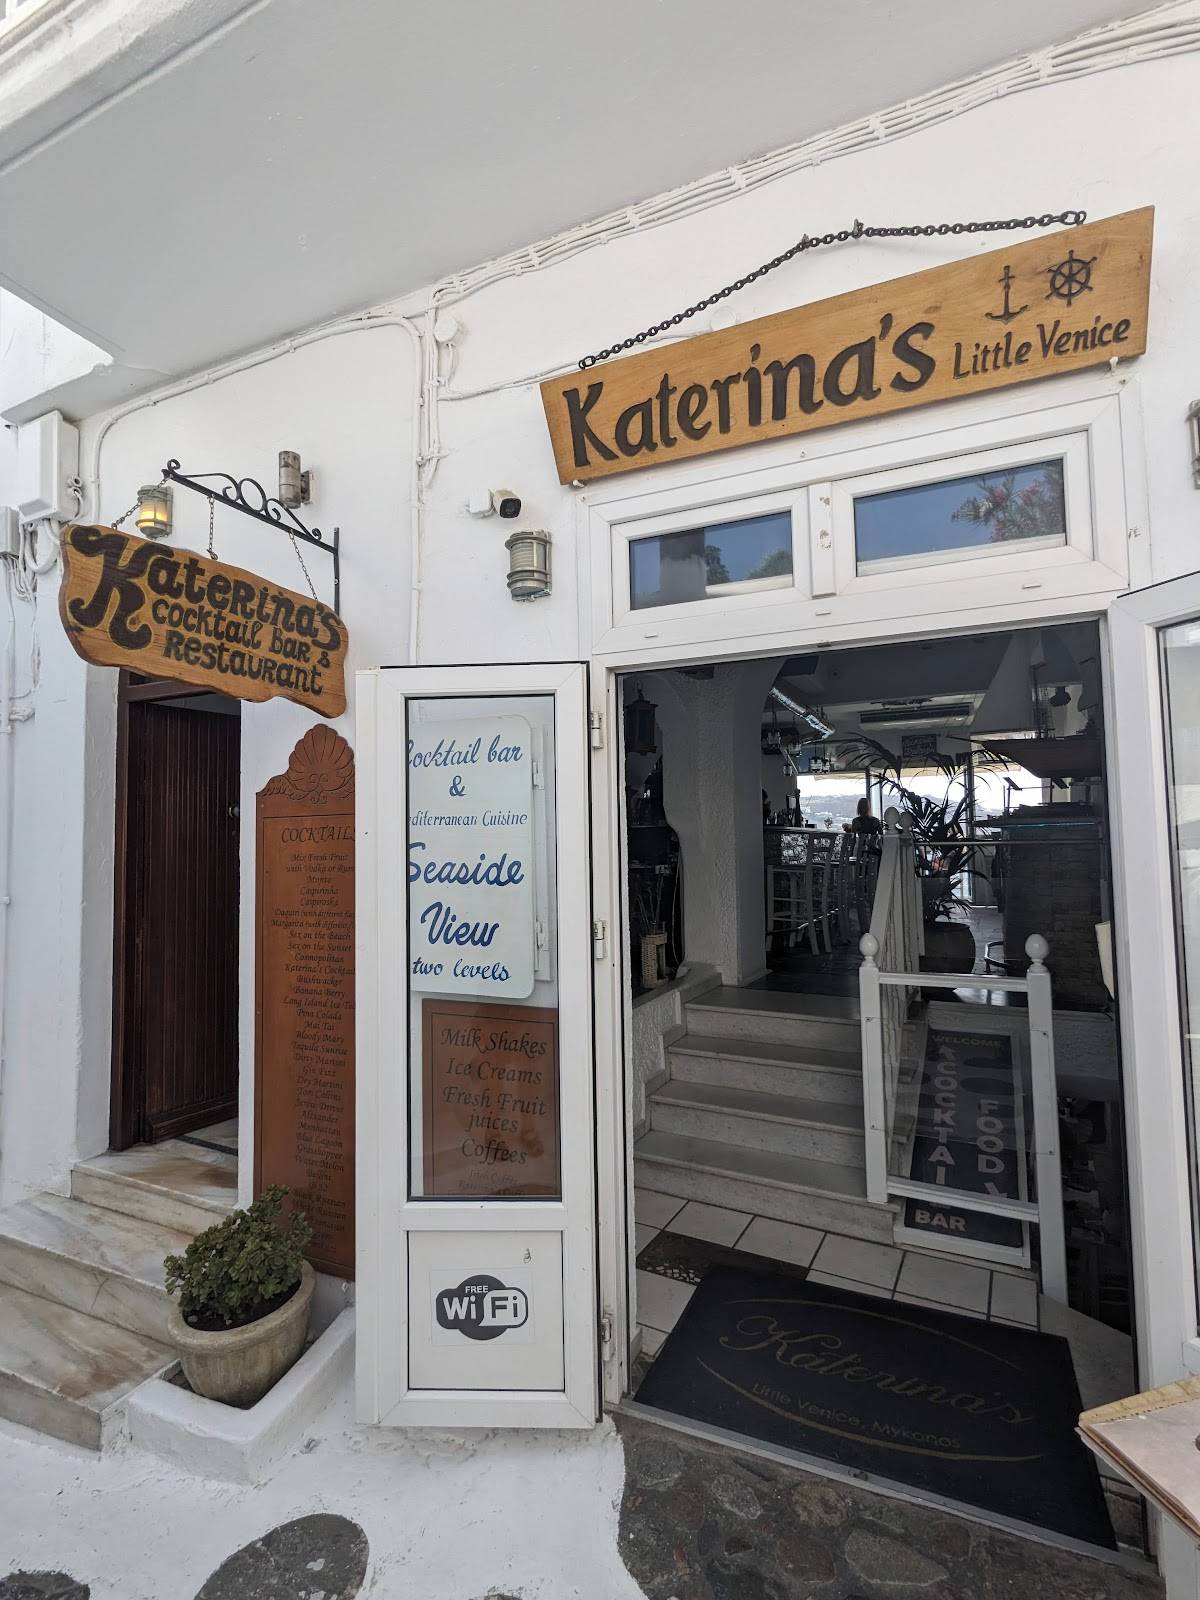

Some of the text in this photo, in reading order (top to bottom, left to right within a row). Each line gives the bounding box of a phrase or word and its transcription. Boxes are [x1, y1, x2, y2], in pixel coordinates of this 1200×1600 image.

[953, 314, 1131, 380] Little Venice
[561, 313, 936, 468] Katerina's
[488, 734, 523, 763] bar
[449, 775, 467, 797] &
[409, 810, 528, 826] diterranean Cuisine
[281, 825, 355, 843] COCKTAIL
[409, 841, 525, 886] Seaside
[421, 901, 500, 947] View
[412, 957, 512, 982] two levels
[441, 1028, 548, 1058] Milk Shakes
[446, 1057, 544, 1085] Ice Creams
[443, 1086, 548, 1116] Fresh Fruit
[465, 1108, 520, 1133] juices
[928, 1062, 958, 1208] COCKTAI
[461, 1137, 528, 1166] Coffees
[914, 1208, 967, 1232] BAR
[465, 1285, 489, 1293] FREE
[752, 1383, 791, 1406] Little
[872, 1420, 962, 1449] Mykonos
